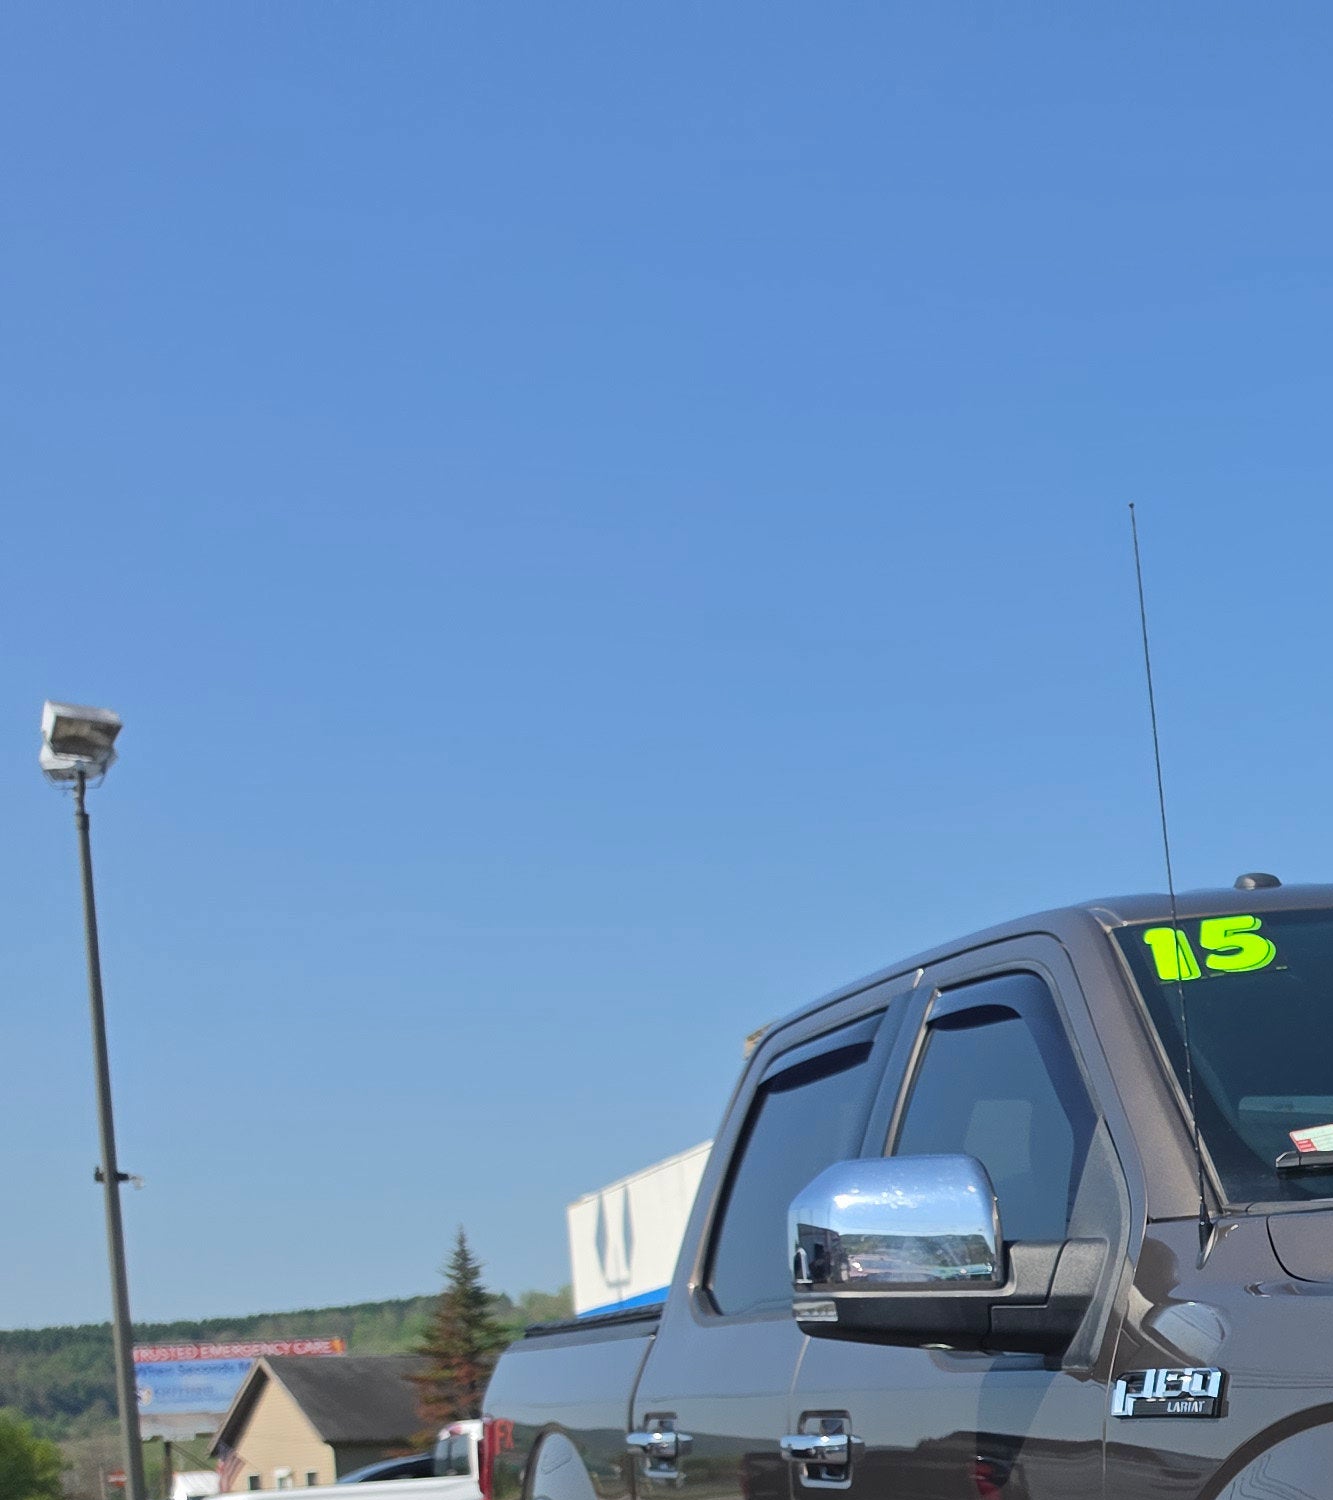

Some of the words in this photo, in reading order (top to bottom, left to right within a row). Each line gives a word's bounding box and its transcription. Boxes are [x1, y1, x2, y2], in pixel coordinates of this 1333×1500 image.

[1143, 915, 1276, 981] 15
[200, 1341, 291, 1360] EMERGENCY
[293, 1340, 332, 1355] CARE
[1166, 1400, 1206, 1413] LARIAT
